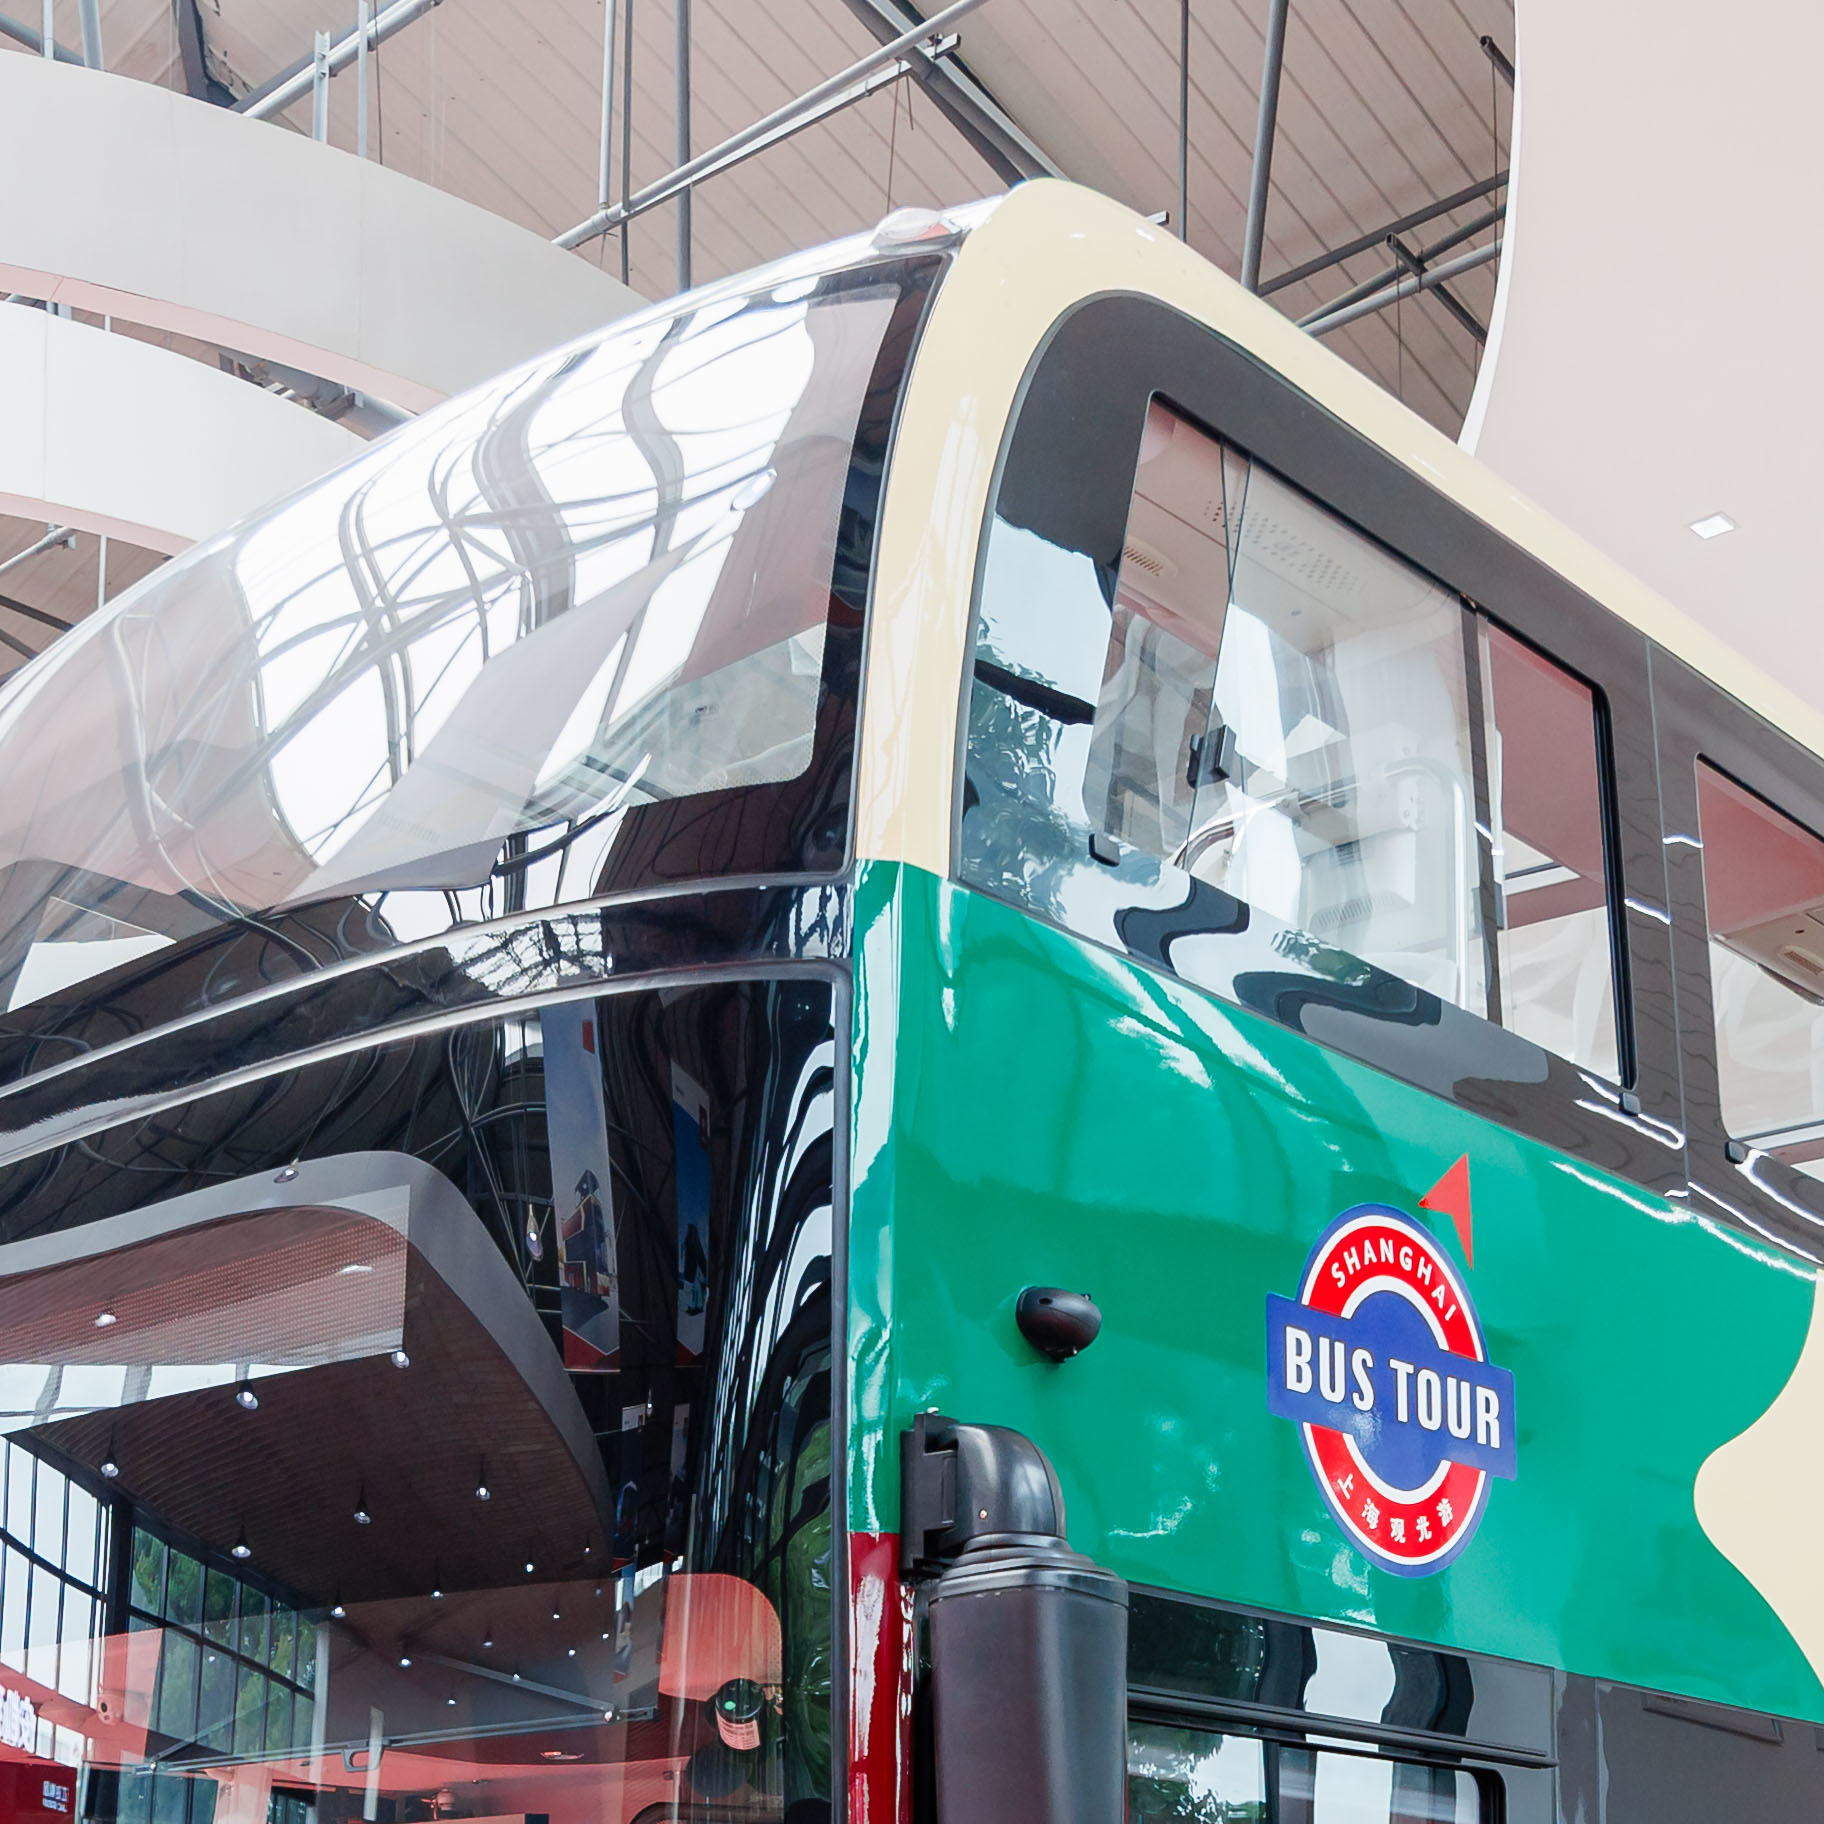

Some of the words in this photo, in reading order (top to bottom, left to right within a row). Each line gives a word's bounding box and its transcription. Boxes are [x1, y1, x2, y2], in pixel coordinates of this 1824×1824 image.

[1331, 1238, 1457, 1321] SHANGHAI
[1285, 1326, 1375, 1412] BUS
[1389, 1359, 1501, 1448] TOUR
